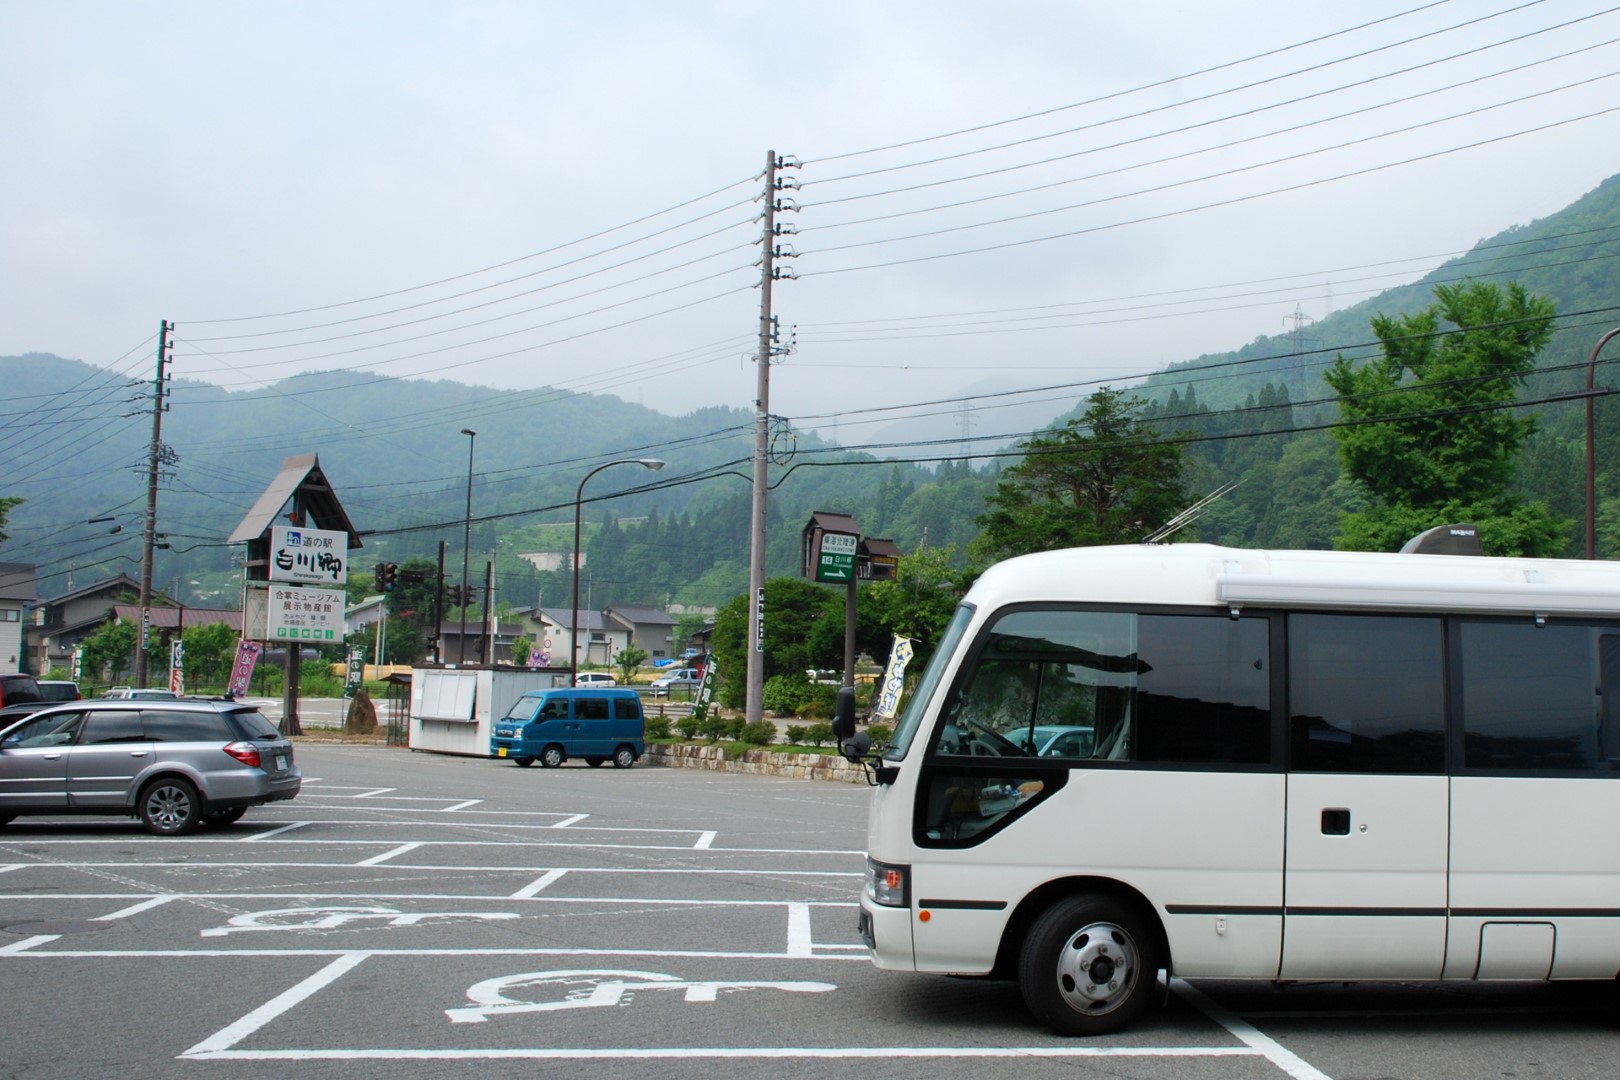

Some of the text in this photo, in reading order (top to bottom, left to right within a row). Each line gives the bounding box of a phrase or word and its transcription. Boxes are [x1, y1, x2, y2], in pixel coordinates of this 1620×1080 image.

[302, 536, 333, 549] 道の駅
[276, 548, 342, 580] 白川郷
[823, 556, 831, 564] 14
[275, 590, 340, 603] 合掌ミュージアム
[283, 601, 332, 613] 展示物産館
[235, 653, 251, 688] 道の駅
[350, 650, 363, 684] 道の駅
[702, 660, 717, 703] 道の駅
